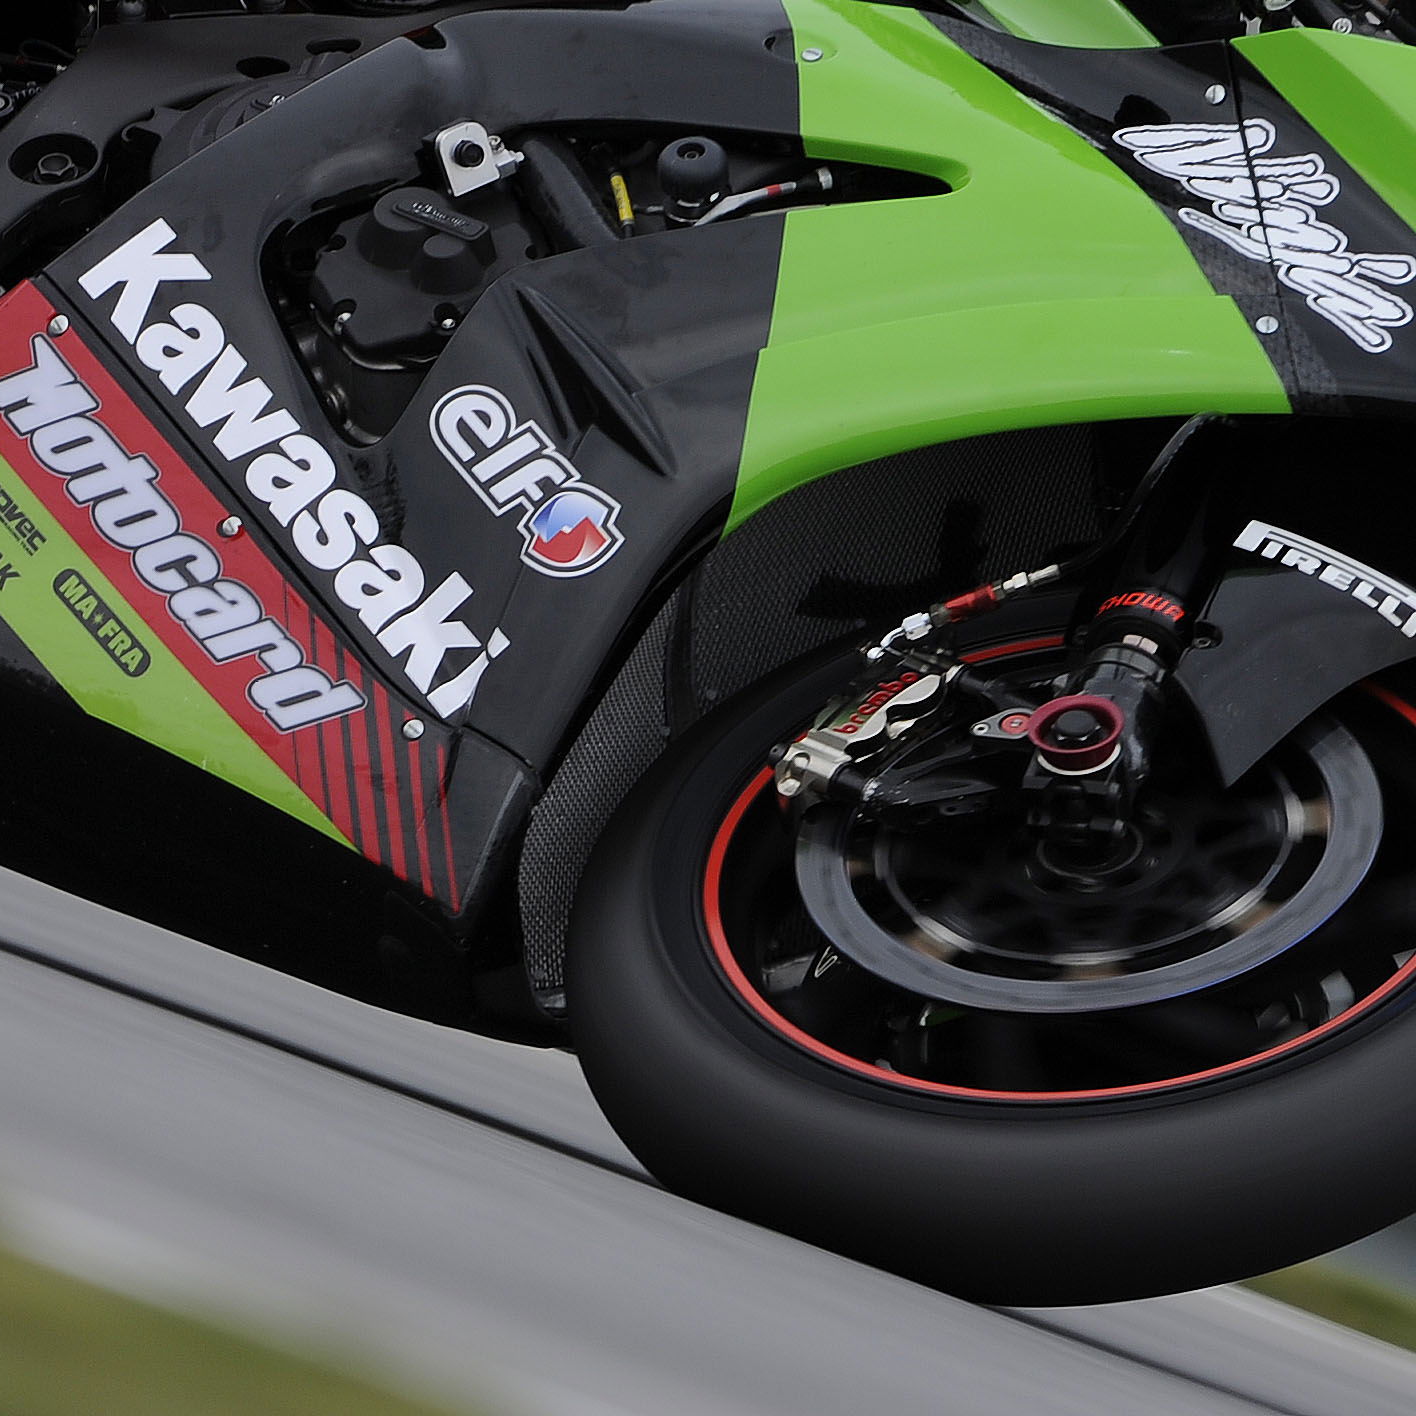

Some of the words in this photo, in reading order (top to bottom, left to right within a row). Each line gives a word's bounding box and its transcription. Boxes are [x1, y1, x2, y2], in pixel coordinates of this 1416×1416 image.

[1112, 118, 1416, 354] Ninja
[77, 217, 511, 719] Kawasaki
[432, 389, 568, 510] elf
[833, 671, 920, 734] brembo
